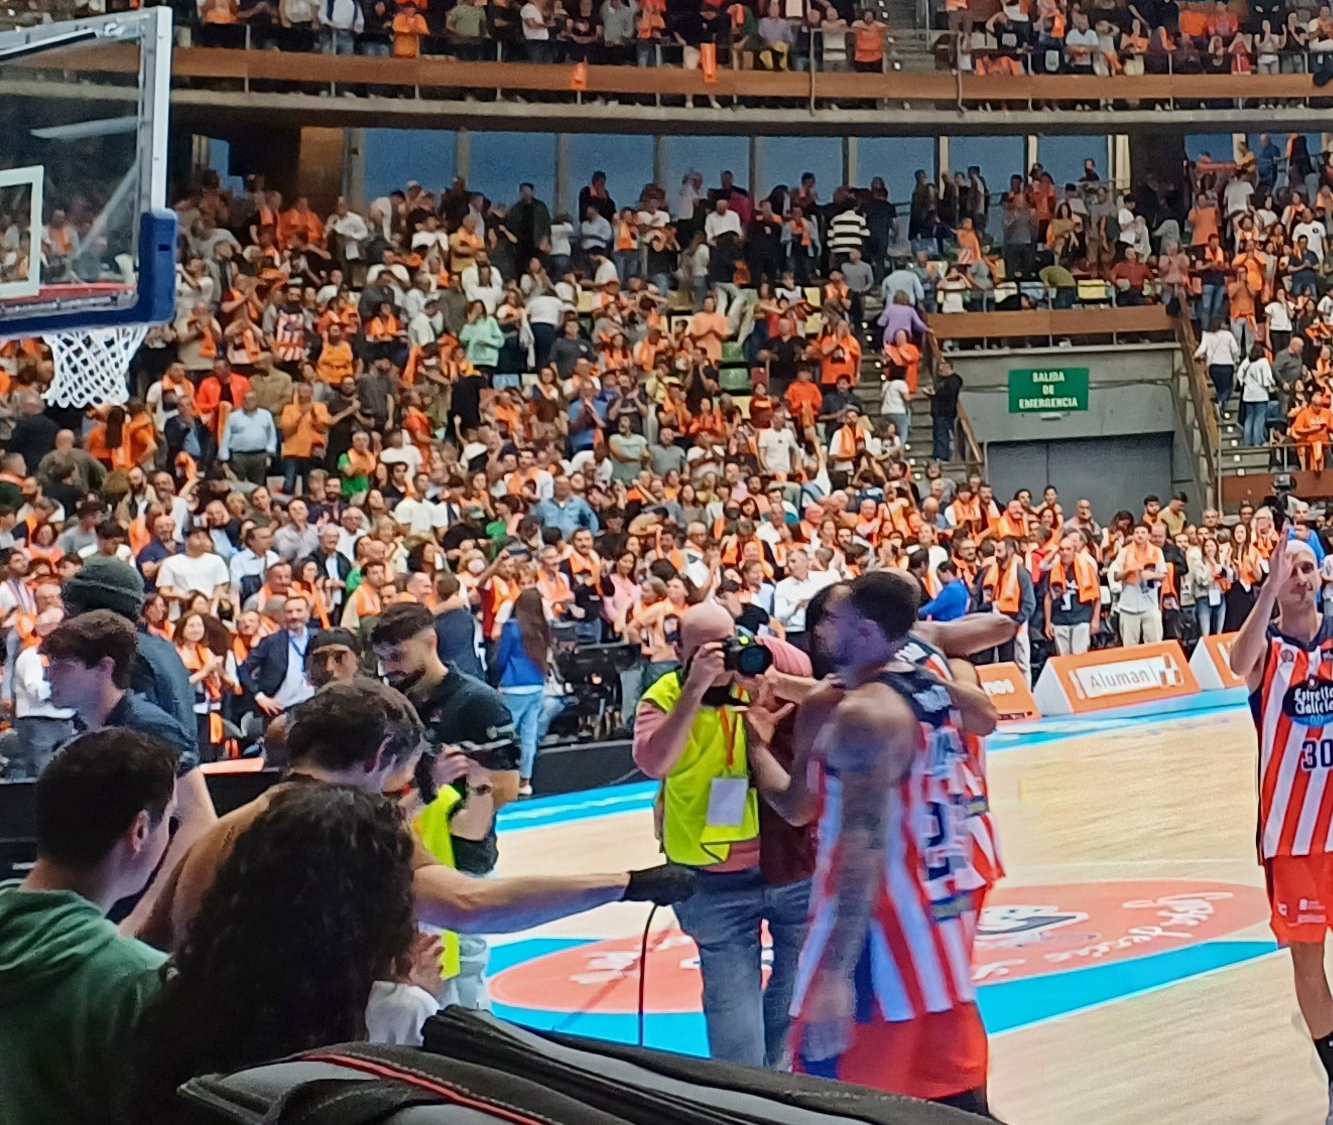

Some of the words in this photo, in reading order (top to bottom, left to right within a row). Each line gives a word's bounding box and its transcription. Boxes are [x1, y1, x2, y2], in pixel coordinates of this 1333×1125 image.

[1032, 371, 1065, 383] SALIDA
[1042, 384, 1054, 395] DE
[1018, 397, 1078, 409] EMERGENCIA
[1089, 668, 1147, 690] Aluman
[1302, 739, 1333, 769] 30
